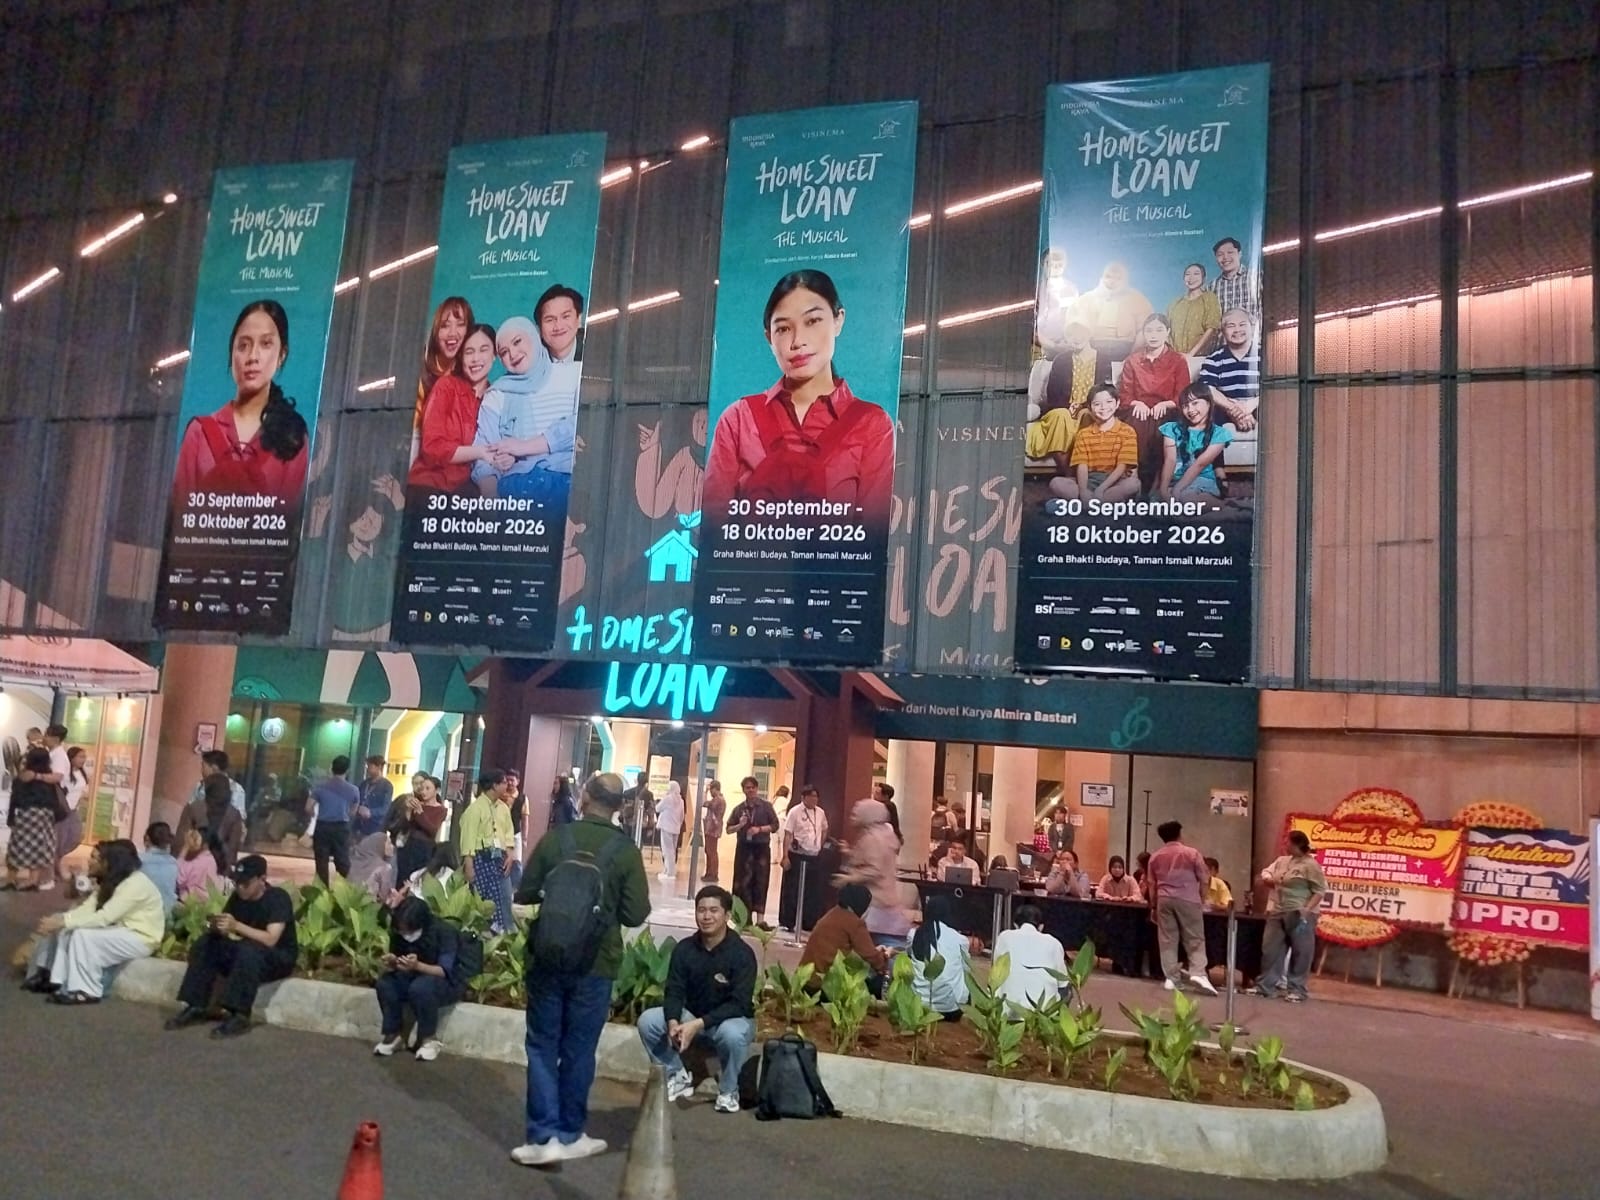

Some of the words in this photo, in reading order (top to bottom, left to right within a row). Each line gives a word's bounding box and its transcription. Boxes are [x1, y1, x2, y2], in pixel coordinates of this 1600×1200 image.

[801, 128, 845, 139] VISINEMA
[1111, 158, 1200, 199] LOAN
[781, 186, 857, 224] LOAN
[1104, 204, 1131, 224] THE
[1136, 203, 1192, 220] MUSICAL
[485, 209, 550, 245] LOAN
[246, 229, 304, 261] LOAN
[773, 232, 796, 248] THE
[801, 228, 849, 245] MUSICAL
[478, 251, 497, 266] THE
[501, 248, 540, 262] MUSICAL
[240, 267, 256, 280] THE
[259, 266, 294, 279] MUSICAL
[188, 492, 205, 507] 30
[208, 493, 277, 511] September
[427, 495, 447, 510] 30
[451, 495, 534, 513] September
[728, 499, 751, 516] 30
[755, 499, 851, 519] September
[1054, 498, 1082, 516] 30
[1088, 497, 1206, 520] September
[182, 514, 196, 528] 18
[199, 514, 250, 529] Oktober
[252, 515, 286, 529] 2026
[421, 518, 437, 533] 18
[441, 518, 501, 534] Oktober
[505, 519, 545, 535] 2026
[721, 524, 740, 540] 18
[744, 523, 814, 541] Oktober
[819, 524, 866, 541] 2026
[1046, 525, 1069, 543] 18
[1075, 525, 1162, 544] Oktober
[1167, 526, 1225, 544] 2026
[413, 541, 432, 550] Graha
[433, 542, 453, 550] Bhakti
[454, 543, 478, 553] Budaya,
[480, 543, 500, 551] Taman
[502, 544, 522, 552] Ismail
[523, 544, 549, 553] Marzuki
[713, 550, 734, 559] Graha
[736, 550, 758, 559] Bhakti
[760, 550, 788, 562] Budaya,
[790, 551, 815, 560] Taman
[816, 551, 839, 560] Ismail
[841, 552, 872, 561] Marzuki
[1037, 555, 1064, 564] Graha
[1065, 555, 1094, 564] Bhakti
[1096, 555, 1131, 567] Budaya,
[1133, 556, 1163, 565] Taman
[1165, 556, 1193, 565] Ismail
[1195, 556, 1233, 566] Marzuki
[709, 593, 726, 604] BSI
[1035, 602, 1055, 614] BSI
[604, 661, 728, 720] LOAN
[906, 703, 927, 714] dari
[929, 704, 959, 716] Novel
[962, 707, 993, 721] Karya
[993, 708, 1031, 721] Almira
[1034, 711, 1077, 724] Bastari
[1369, 828, 1382, 844] &
[1385, 828, 1435, 849] Sukses
[1376, 870, 1391, 880] THE
[1371, 885, 1400, 896] BESAR
[1338, 895, 1406, 914] LOKET
